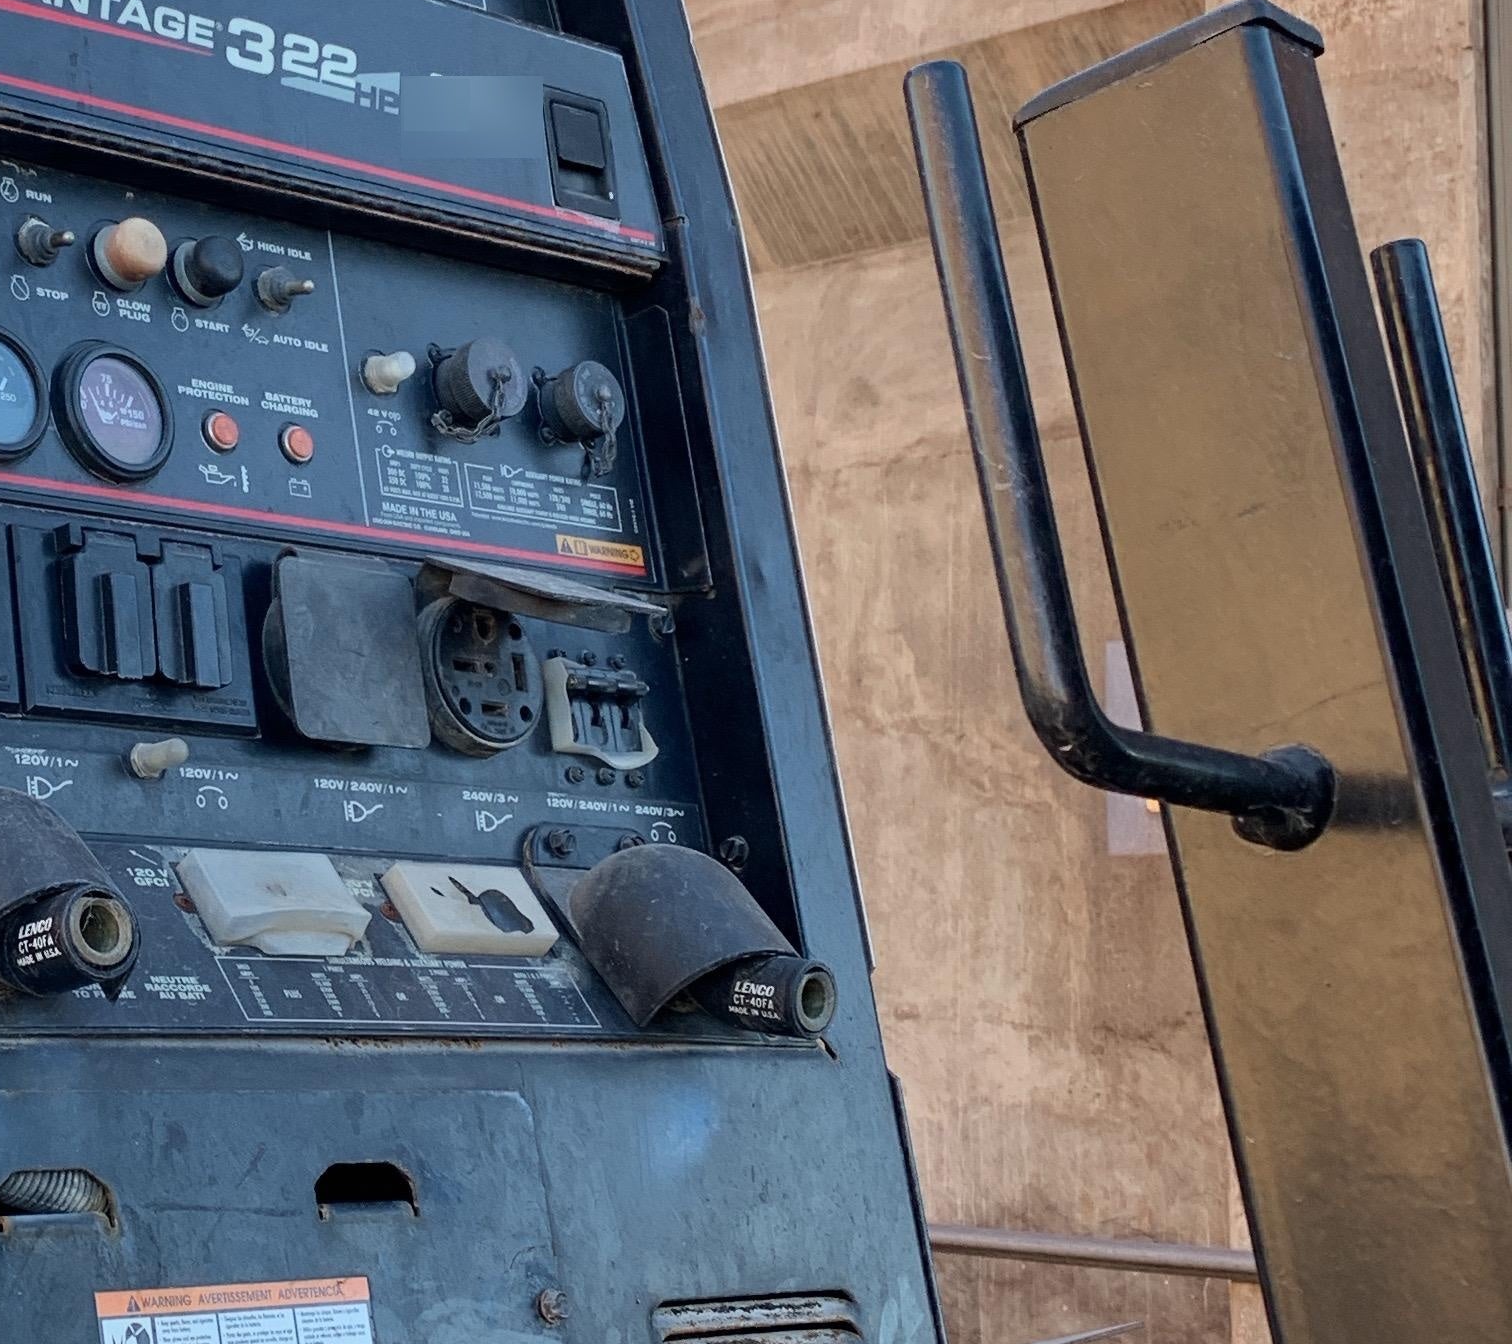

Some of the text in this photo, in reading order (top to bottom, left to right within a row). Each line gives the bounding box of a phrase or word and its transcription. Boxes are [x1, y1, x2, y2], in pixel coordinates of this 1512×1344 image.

[225, 16, 358, 88] 322
[25, 189, 52, 204] RUN
[257, 241, 312, 262] HIGH IDLE
[36, 286, 69, 302] STOP
[116, 298, 151, 314] GLOW
[119, 308, 152, 324] PLUG
[194, 318, 230, 334] START
[273, 334, 329, 354] AUTO IDLE
[191, 378, 234, 395] ENGINE
[177, 384, 250, 407] PROTECTION
[264, 391, 312, 408] BATTERY
[261, 399, 319, 419] CHARGING
[382, 502, 408, 515] MADE
[409, 506, 419, 516] IN
[420, 508, 438, 520] THE
[439, 511, 457, 522] USA
[588, 544, 629, 560] WARNING
[126, 867, 170, 878] 120 V
[133, 876, 171, 887] GFCI
[18, 917, 53, 940] LENCO
[18, 932, 55, 954] CT-40FA
[16, 954, 35, 967] MADE
[35, 951, 44, 962] IN
[144, 983, 212, 993] RACCORDE
[149, 975, 200, 985] NEUTRE
[72, 990, 90, 999] TO
[159, 992, 176, 1000] AU
[734, 980, 775, 997] LENCO
[733, 994, 774, 1010] CT-40FA
[728, 1006, 749, 1016] MADE
[141, 1284, 346, 1308] WARNING AVERTISSEMENT ADVERTENCIA
